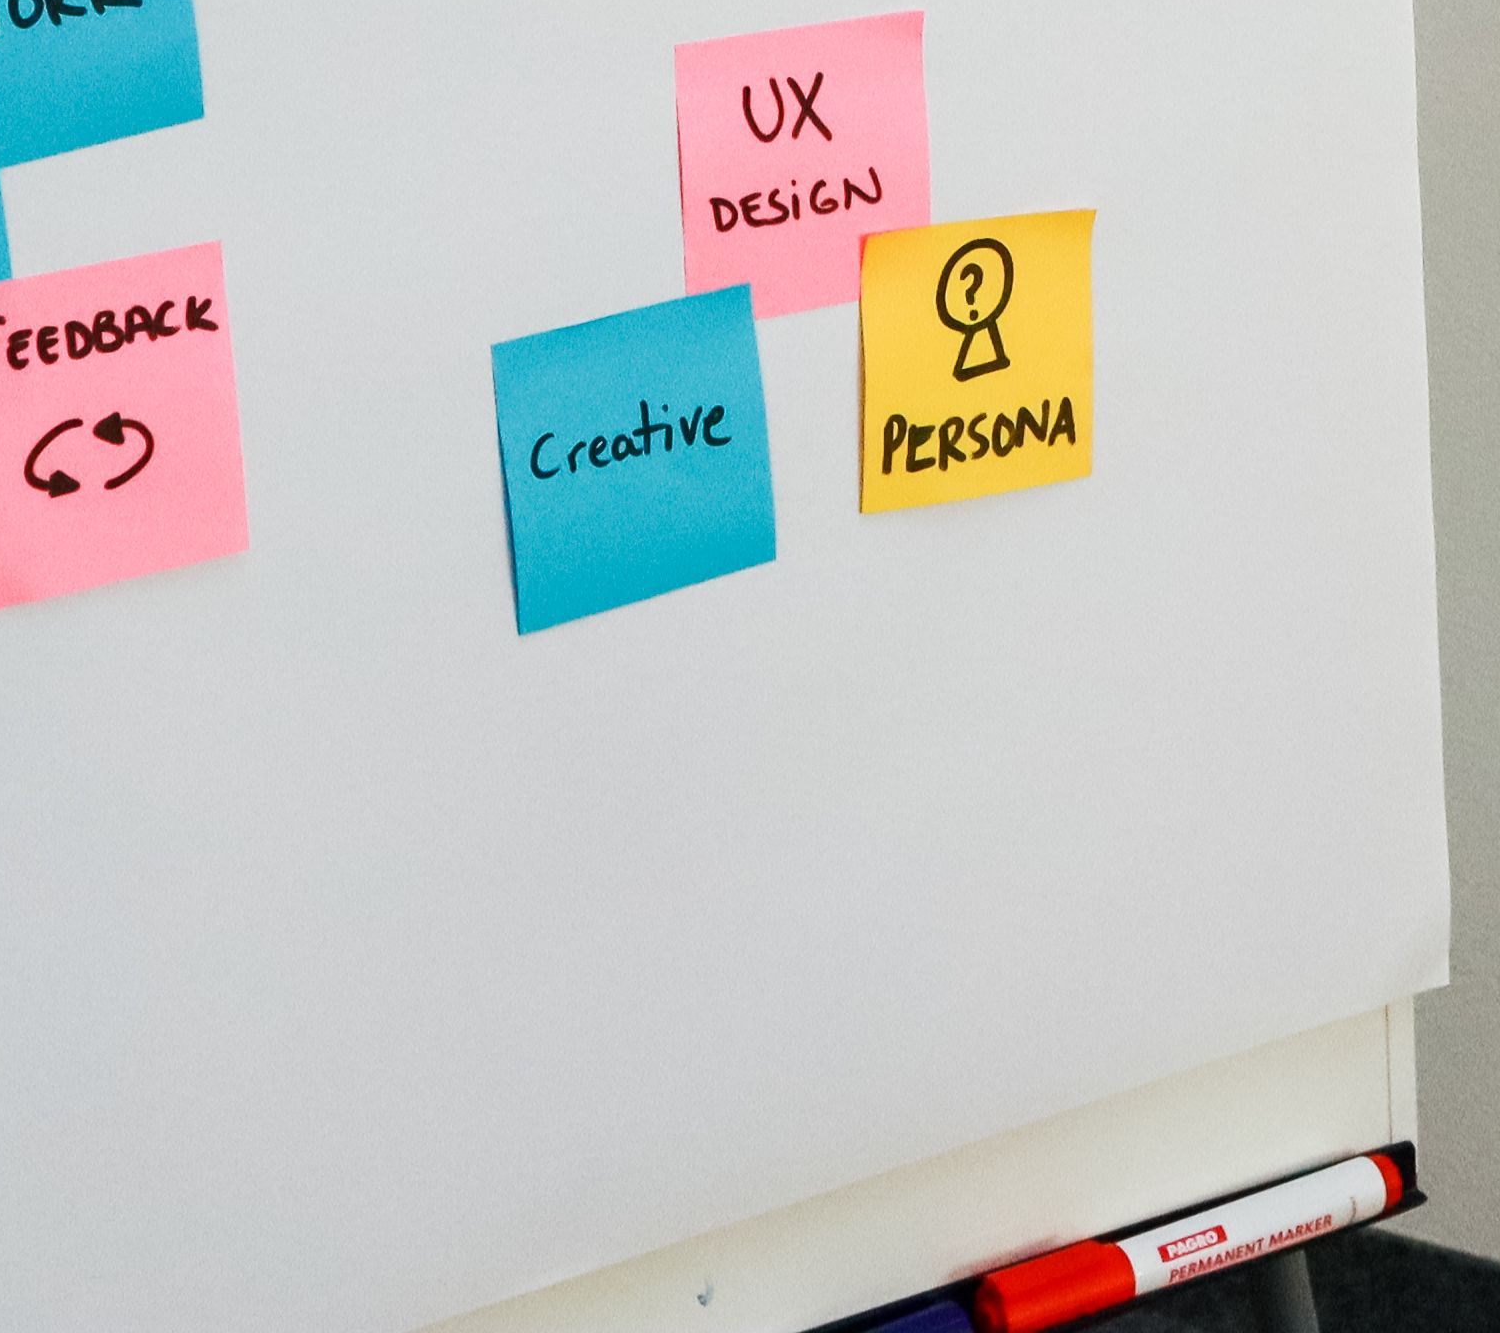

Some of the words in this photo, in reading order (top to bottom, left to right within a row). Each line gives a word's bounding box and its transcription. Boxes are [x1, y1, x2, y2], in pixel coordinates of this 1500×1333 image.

[742, 72, 832, 142] UX
[530, 400, 732, 479] Creative
[881, 396, 1075, 475] PERSONA
[1169, 1238, 1264, 1283] PERMANENT
[1269, 1214, 1333, 1247] MARKER
